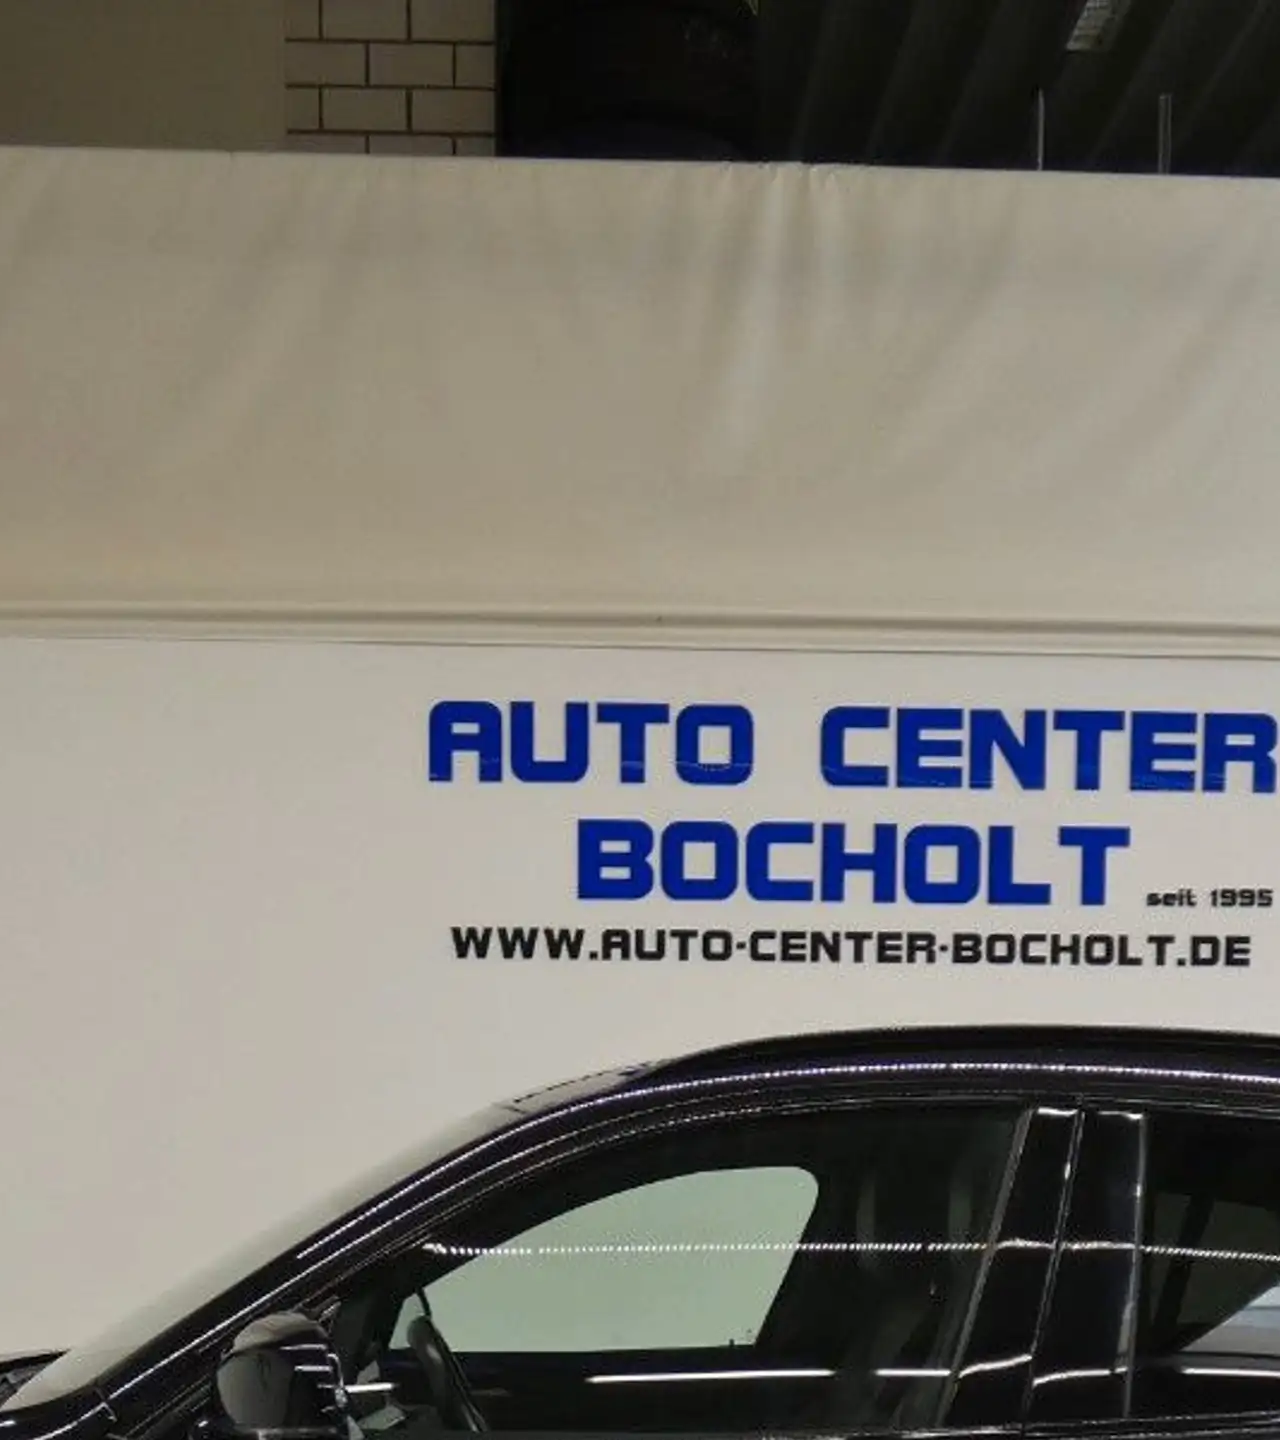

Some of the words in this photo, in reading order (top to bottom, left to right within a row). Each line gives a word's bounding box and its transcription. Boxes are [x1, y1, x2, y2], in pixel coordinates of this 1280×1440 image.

[428, 701, 755, 787] AUTO
[820, 707, 1279, 794] CENTER
[577, 818, 1131, 906] BOCHOLT
[1146, 888, 1197, 908] seit
[1209, 888, 1274, 908] 1995
[450, 926, 1252, 967] WWW.AUTO-CENTER-BOCHOLT.DE
